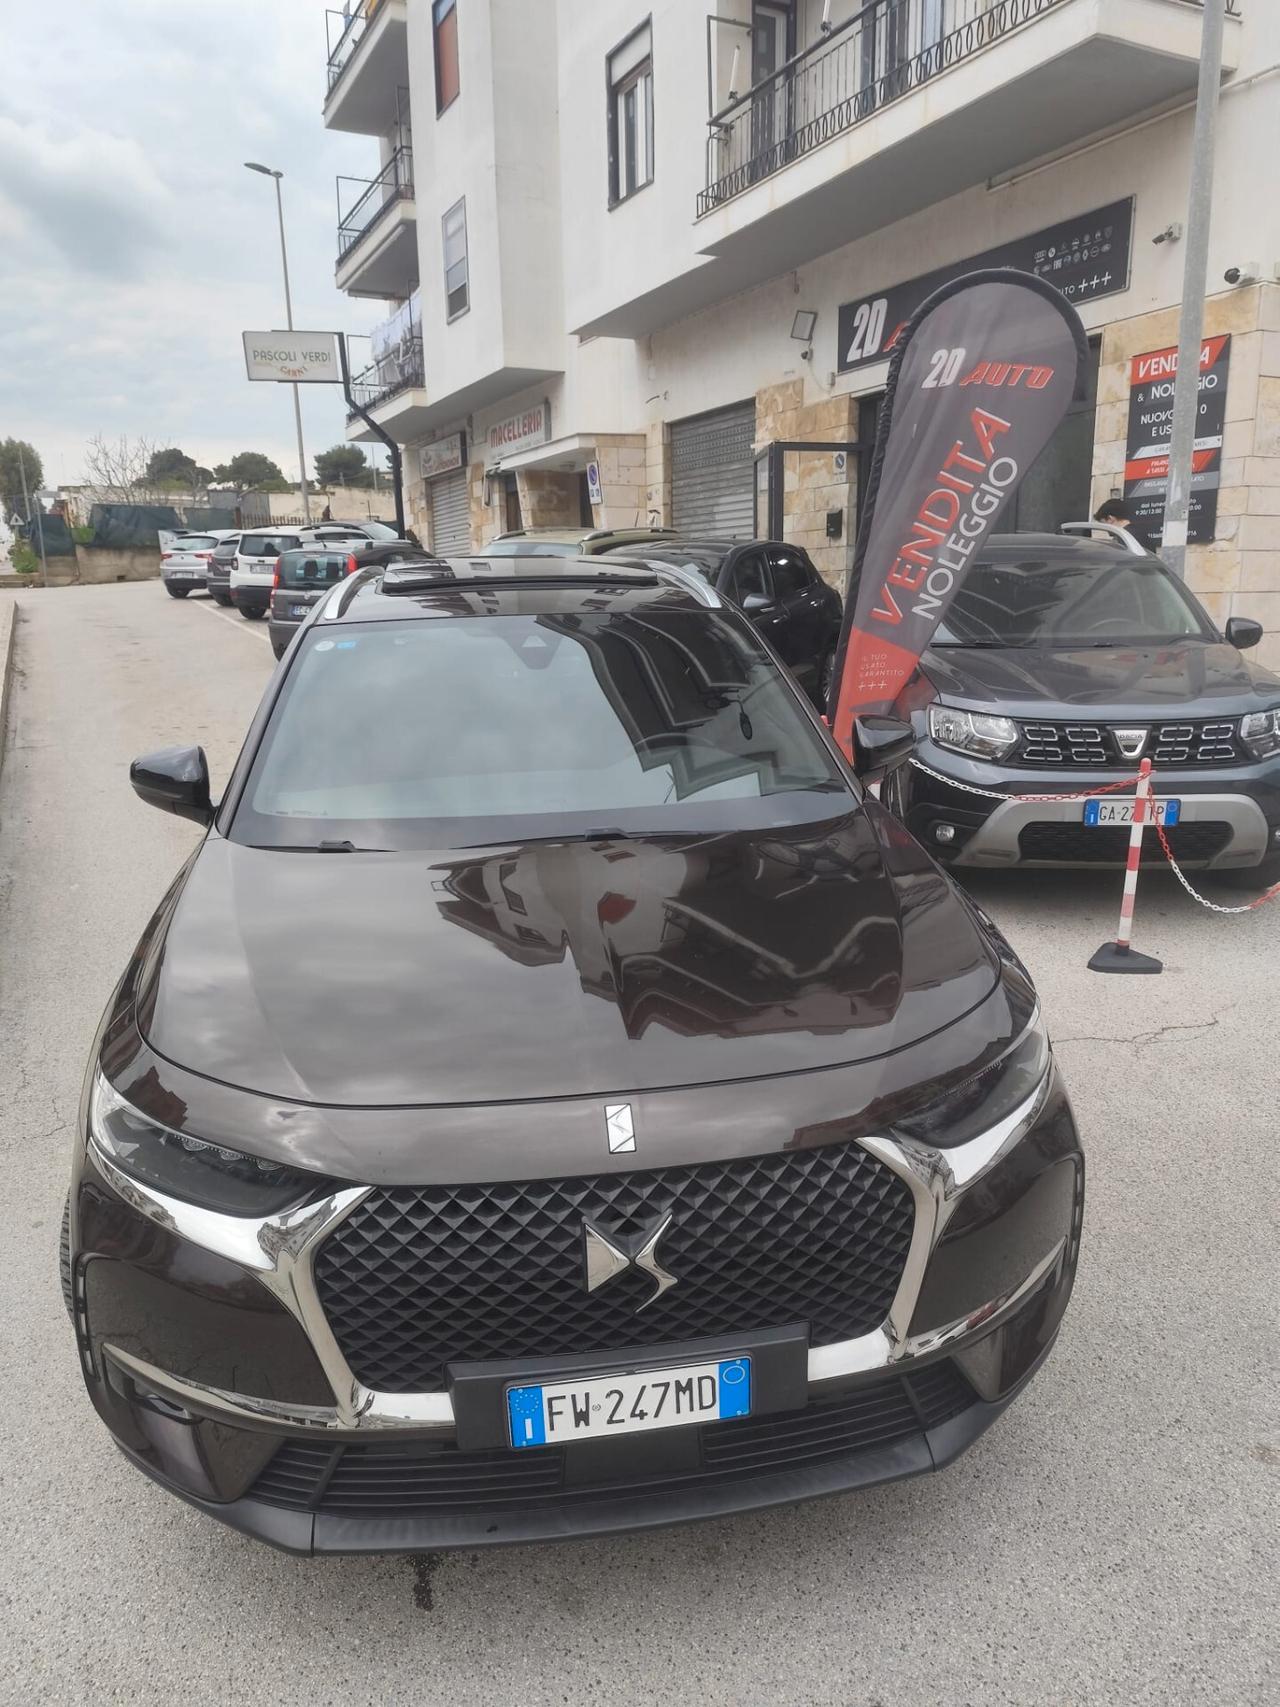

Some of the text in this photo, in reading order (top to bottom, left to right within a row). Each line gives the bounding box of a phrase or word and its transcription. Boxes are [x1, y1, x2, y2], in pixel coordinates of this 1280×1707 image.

[253, 350, 331, 362] PASCOLI VERDI
[959, 360, 1054, 389] AUTO
[490, 409, 542, 449] MACELLERIA
[868, 406, 1012, 626] VENDITA
[911, 456, 1019, 621] NOLEGGIO
[871, 653, 888, 661] TUO
